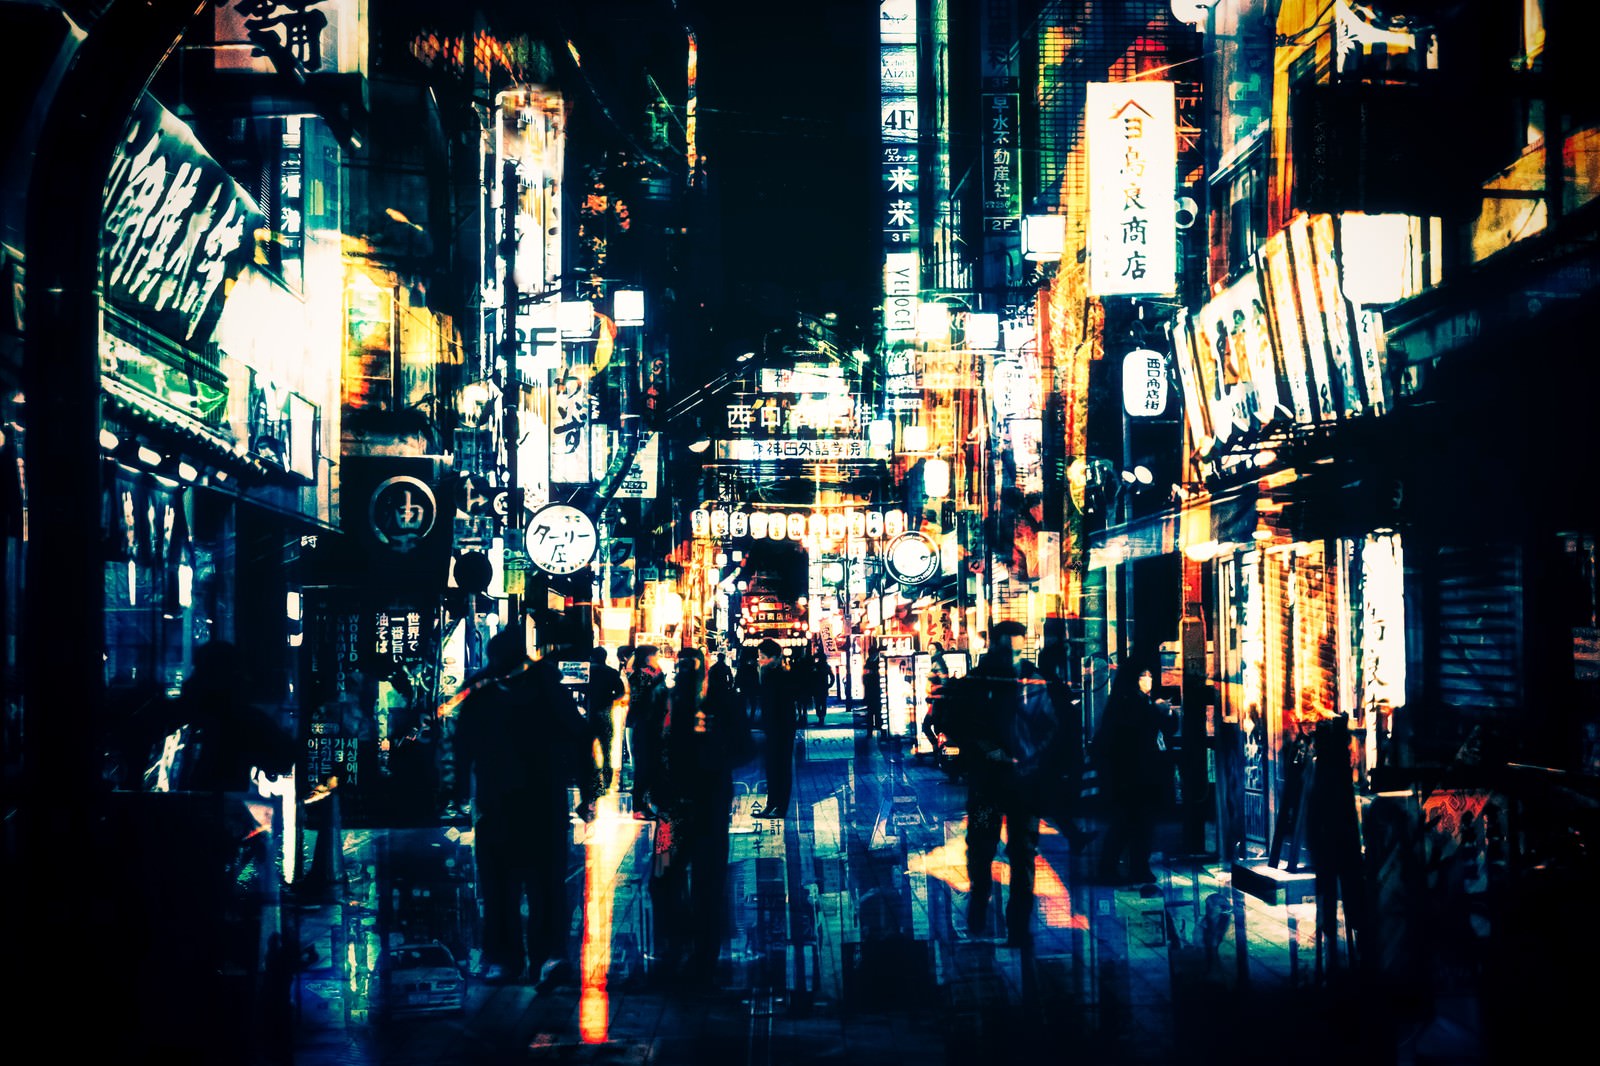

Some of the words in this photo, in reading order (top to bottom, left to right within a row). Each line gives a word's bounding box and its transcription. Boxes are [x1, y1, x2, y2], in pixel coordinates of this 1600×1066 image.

[885, 109, 914, 130] 4F
[892, 233, 911, 242] 3F
[992, 220, 1013, 231] 2F
[533, 524, 590, 544] ターリー
[349, 614, 359, 662] WORLD
[376, 612, 389, 654] 油そば
[391, 616, 405, 663] 一番旨い
[407, 612, 420, 652] 世界で
